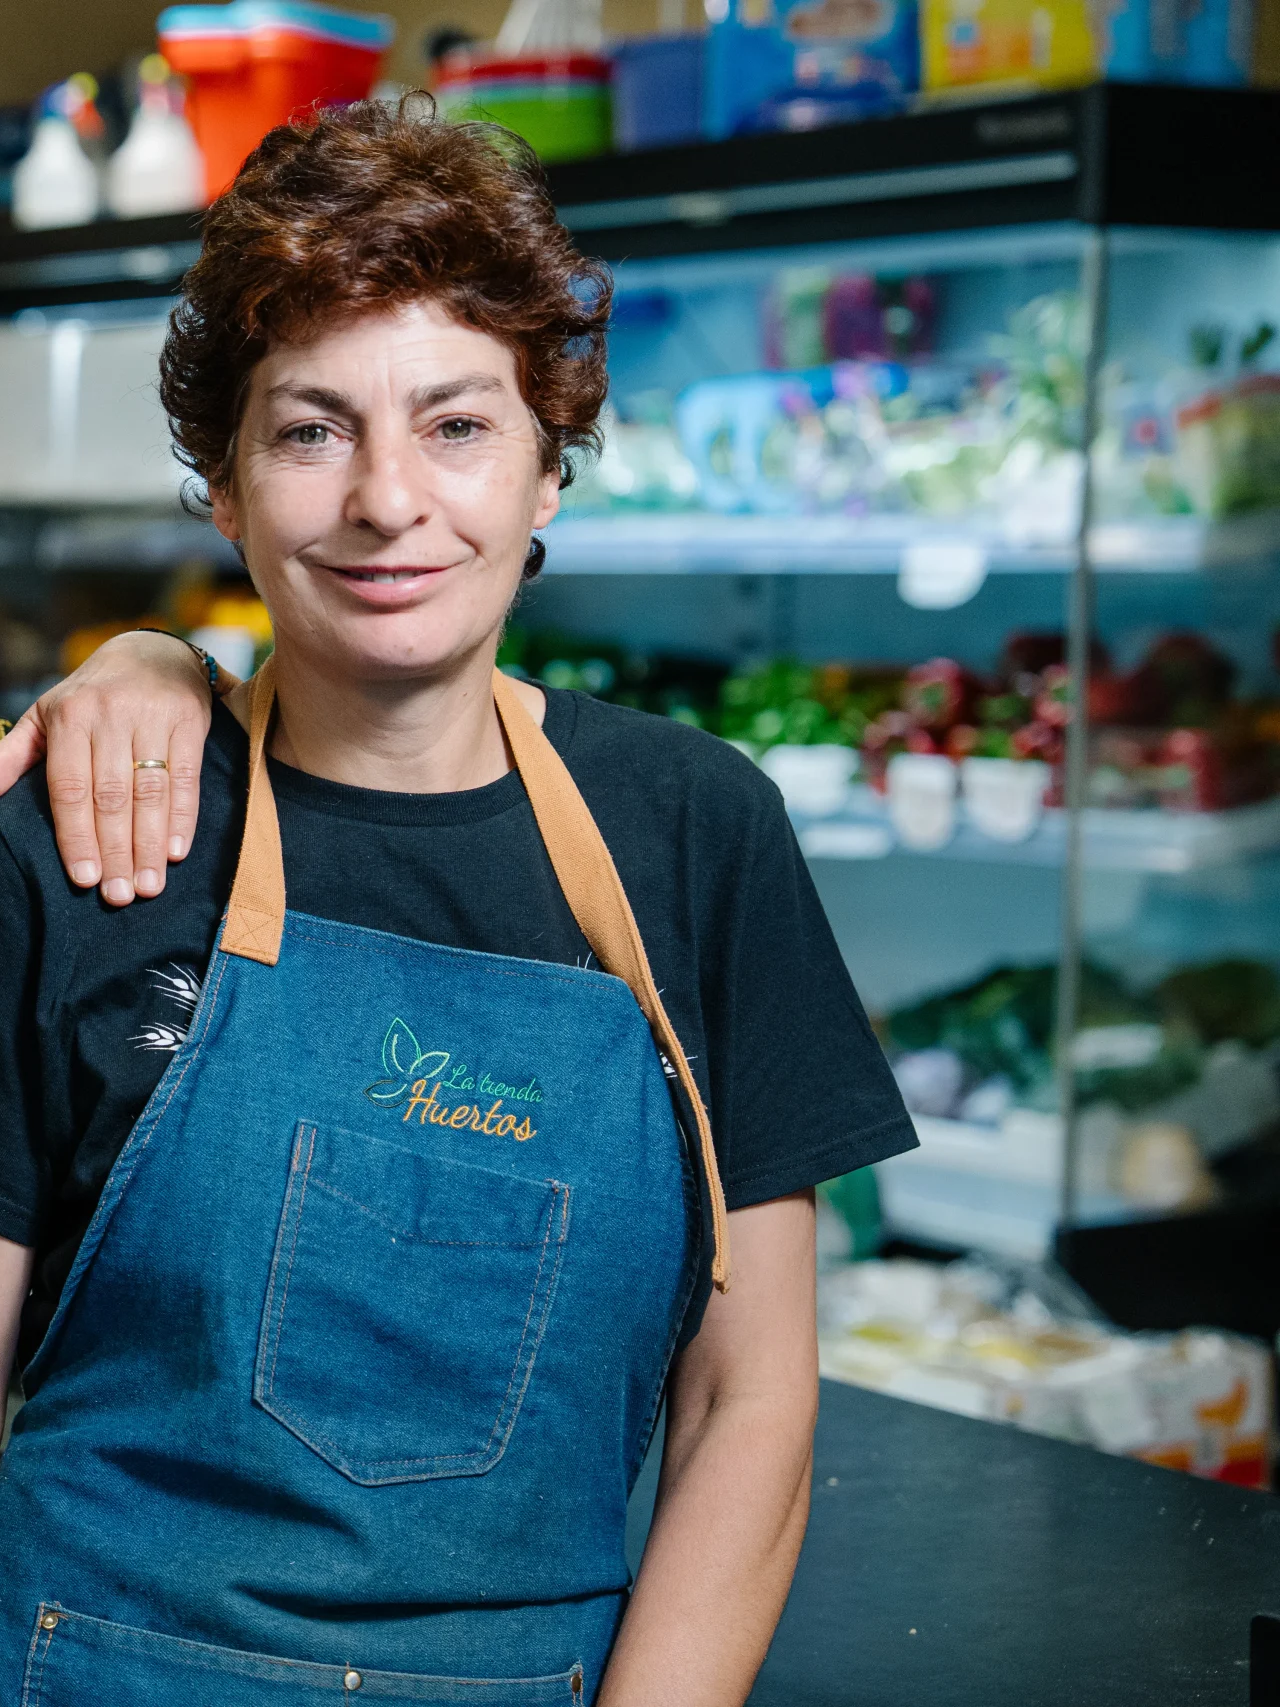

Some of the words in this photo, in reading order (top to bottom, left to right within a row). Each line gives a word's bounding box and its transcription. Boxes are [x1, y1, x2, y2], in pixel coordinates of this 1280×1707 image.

[442, 1064, 475, 1091] La
[480, 1073, 543, 1103] tienda
[403, 1079, 537, 1141] Huertos
